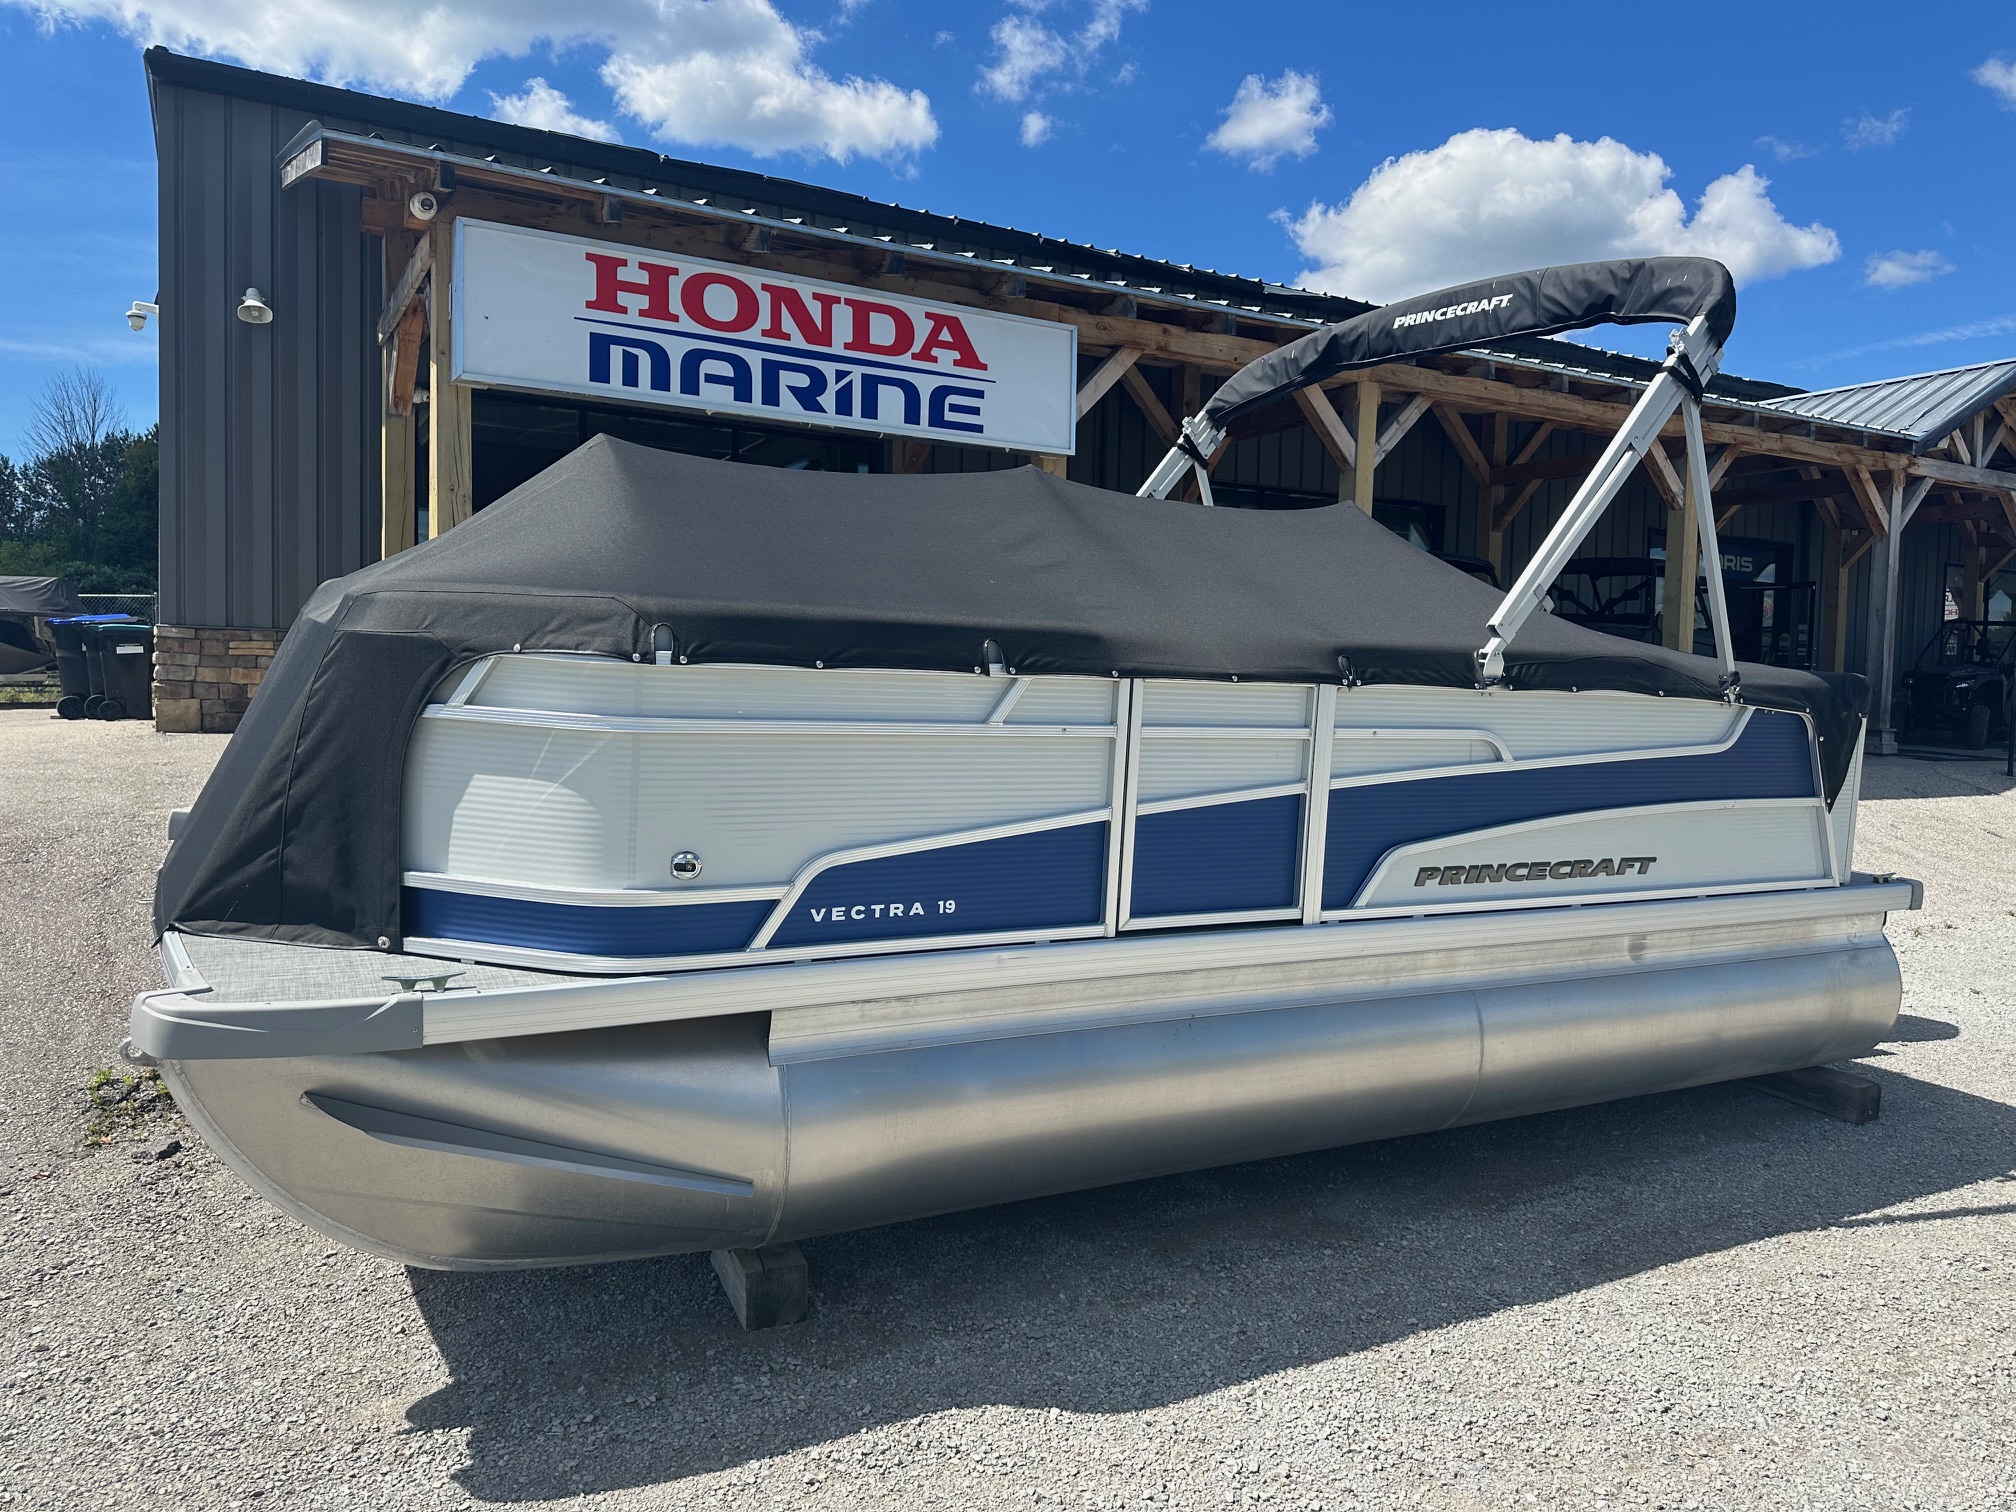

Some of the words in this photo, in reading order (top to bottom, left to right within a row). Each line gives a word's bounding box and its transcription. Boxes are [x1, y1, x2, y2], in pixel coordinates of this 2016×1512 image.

[585, 252, 988, 371] HONDA
[1392, 294, 1513, 329] PRINCECRAFT
[589, 332, 985, 434] MARINE
[1414, 857, 1657, 886] PRINCECRAFT
[810, 902, 925, 922] VECTRA
[937, 900, 956, 914] 19
